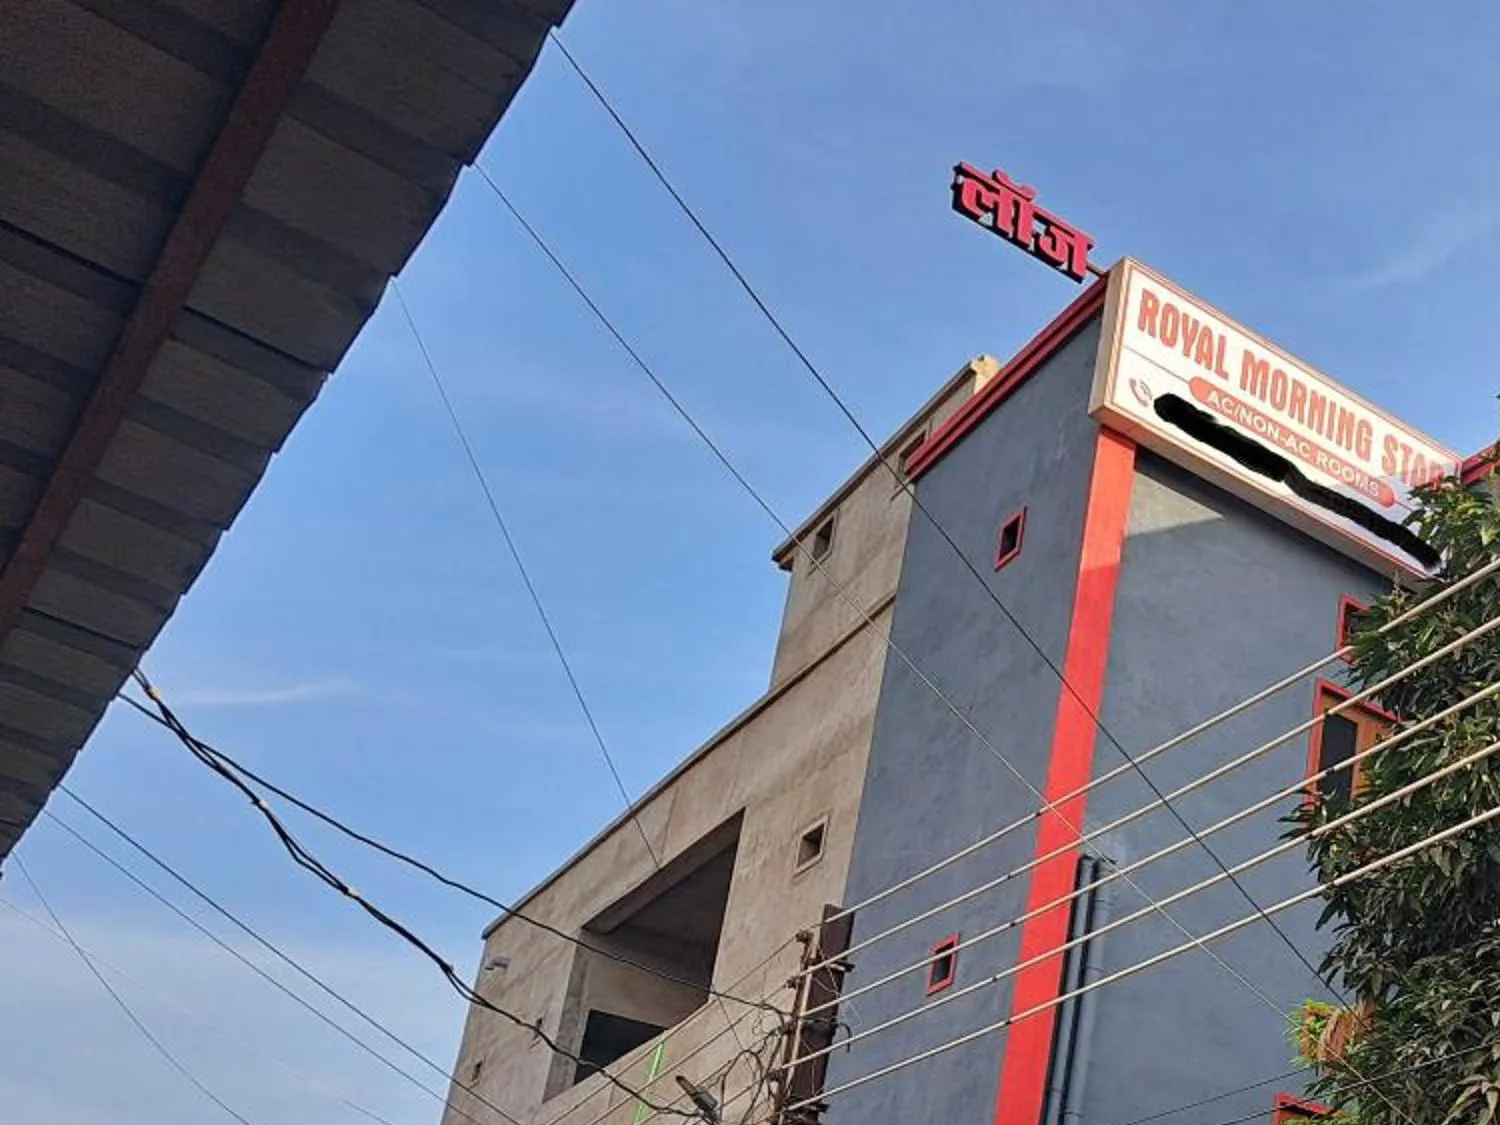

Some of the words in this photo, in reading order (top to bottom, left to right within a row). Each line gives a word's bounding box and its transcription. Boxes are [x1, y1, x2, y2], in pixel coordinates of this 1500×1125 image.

[952, 162, 1094, 283] लॉज
[1138, 288, 1229, 380] ROYAL
[1239, 349, 1374, 463] MORNING
[1207, 389, 1314, 458] AC/NON-AC
[1316, 449, 1381, 497] ROOMS
